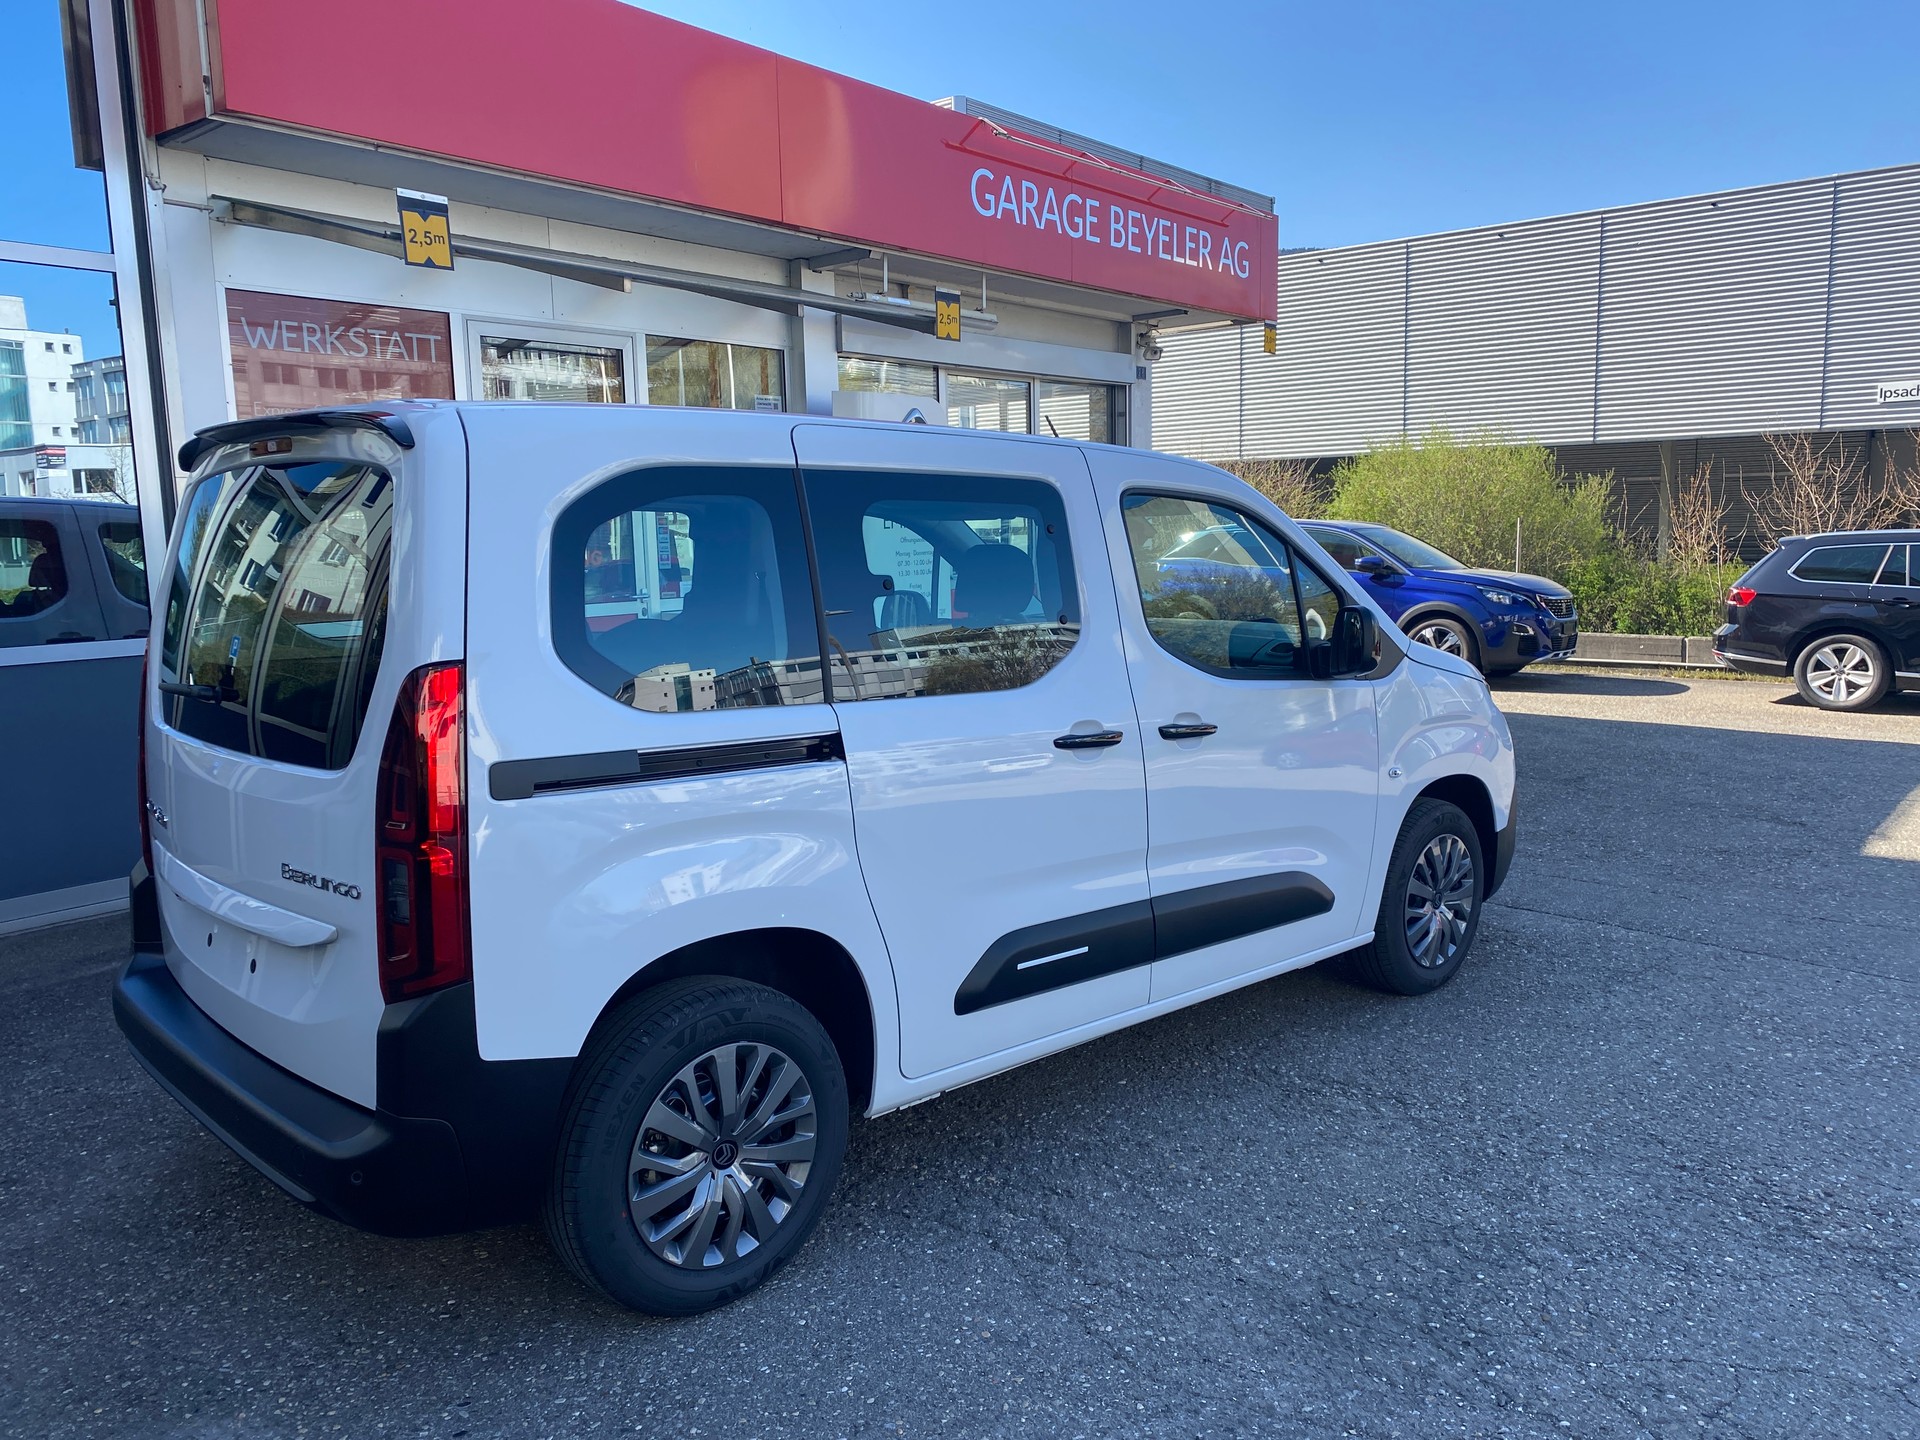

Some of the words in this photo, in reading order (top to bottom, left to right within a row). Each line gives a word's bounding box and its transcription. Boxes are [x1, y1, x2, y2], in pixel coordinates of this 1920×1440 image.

[408, 228, 446, 248] 2,5m
[970, 168, 1100, 243] GARAGE
[1110, 205, 1213, 270] BEYELER
[1218, 237, 1249, 279] AG
[939, 313, 958, 326] 2,5m
[240, 316, 442, 364] WERKSTATT
[254, 402, 304, 416] Expre
[600, 1073, 647, 1156] NEXEN
